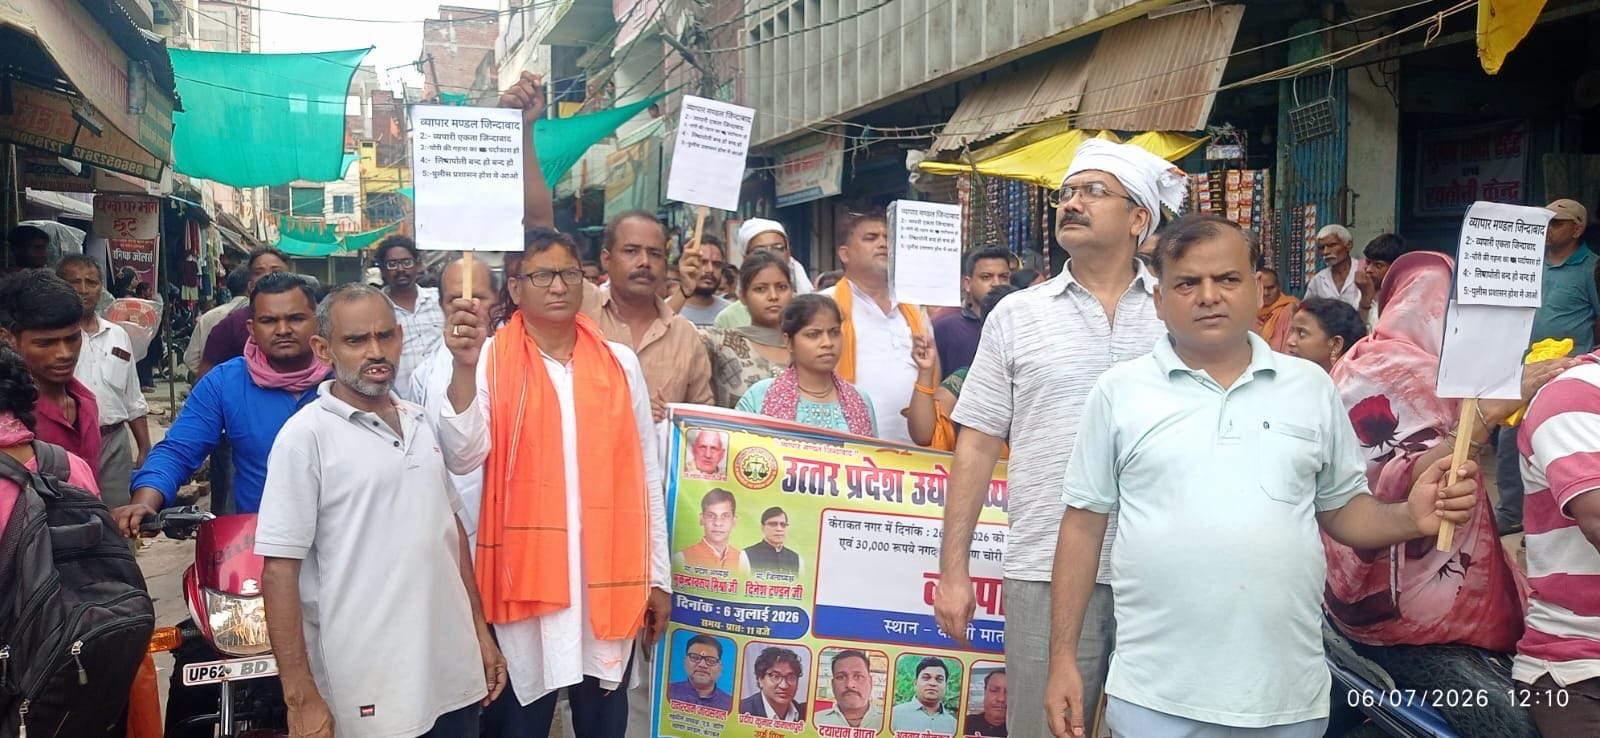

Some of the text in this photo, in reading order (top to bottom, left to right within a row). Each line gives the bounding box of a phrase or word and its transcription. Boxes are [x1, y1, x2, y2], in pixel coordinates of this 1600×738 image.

[420, 118, 448, 128] व्यापार
[452, 120, 478, 128] मण्डल
[484, 158, 490, 166] हो
[1469, 217, 1545, 236] व्यापार मण्डल जिन्दाबाद
[781, 455, 840, 497] उत्तर
[846, 456, 905, 503] प्रदेश
[828, 516, 861, 531] केराकत
[864, 522, 882, 533] नगर
[885, 521, 893, 533] में
[895, 523, 923, 537] दिनांक
[992, 531, 1004, 542] को
[839, 538, 854, 550] एवं
[856, 540, 889, 552] 30,000
[983, 549, 1002, 561] चोरी
[727, 579, 738, 594] जी
[746, 582, 803, 600] दिनेश टण्डन जी
[676, 595, 713, 613] दिनांक
[723, 606, 730, 617] 6
[734, 605, 770, 622] जुलाई
[772, 610, 799, 623] 2026
[746, 626, 754, 635] 11
[755, 626, 770, 636] बजे
[883, 619, 919, 635] स्थान
[189, 661, 268, 681] UP62 BD
[755, 717, 773, 728] कुमार
[819, 726, 876, 738] दयाराम गप्ता
